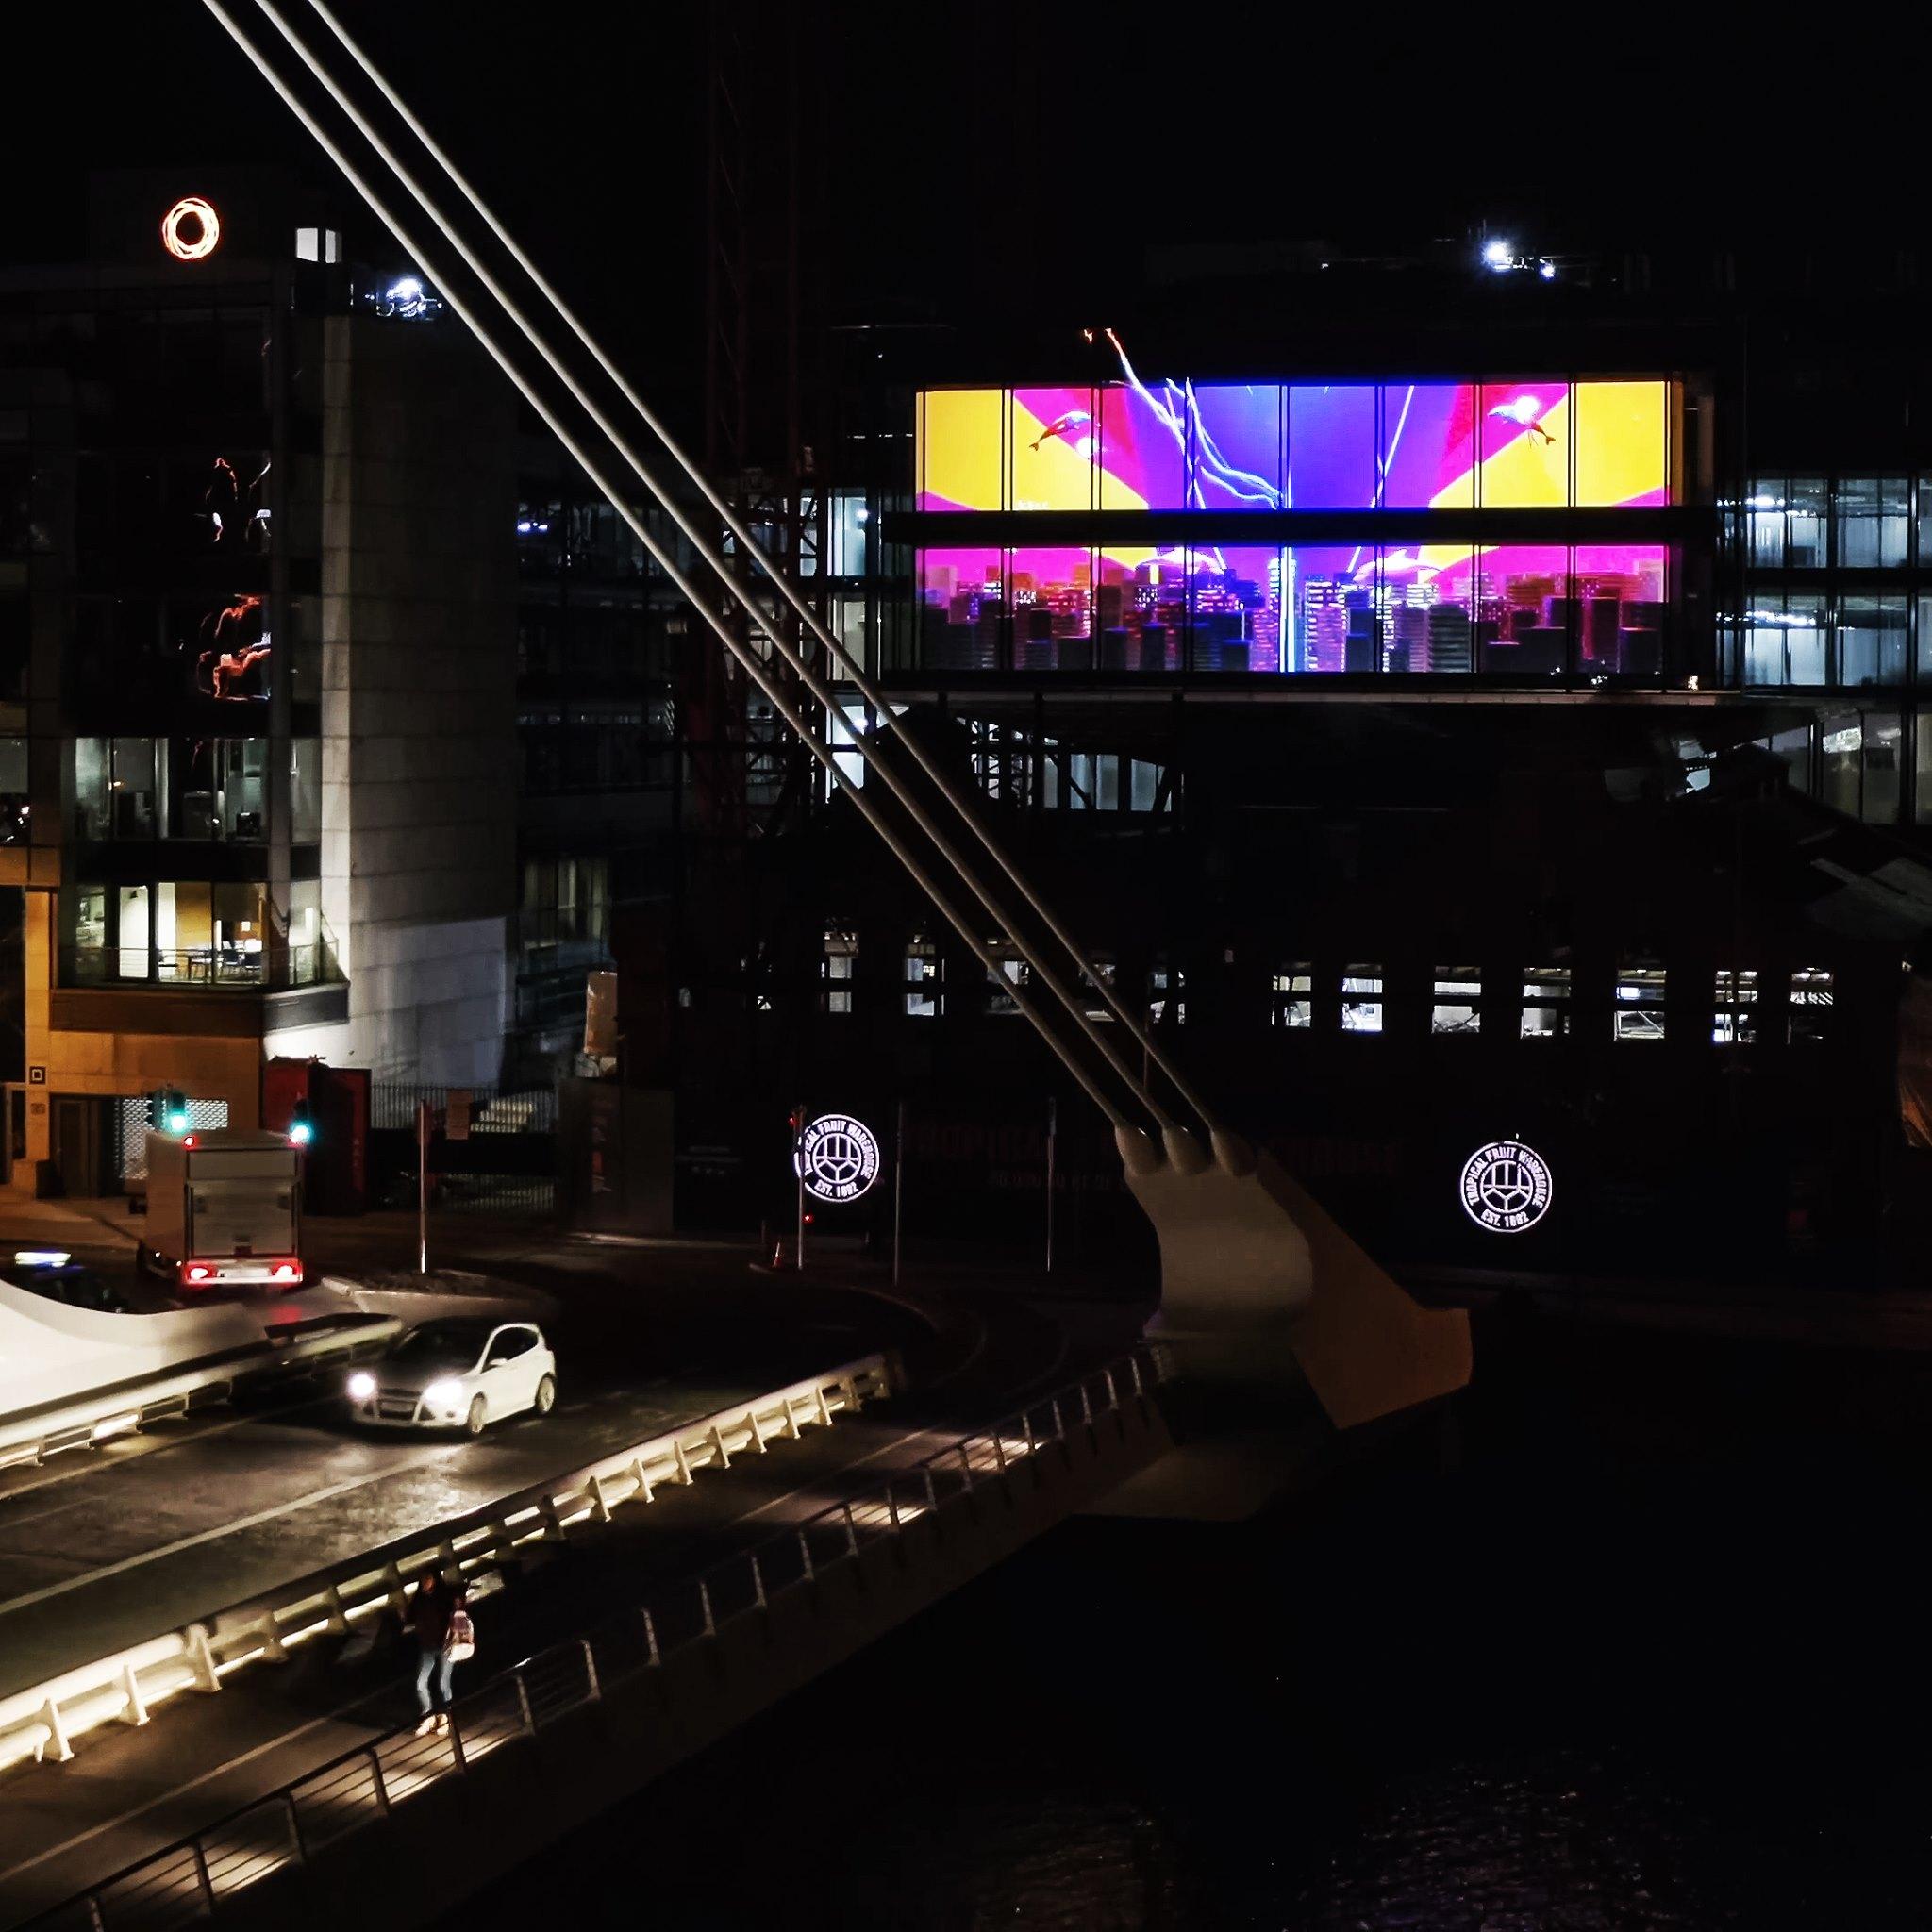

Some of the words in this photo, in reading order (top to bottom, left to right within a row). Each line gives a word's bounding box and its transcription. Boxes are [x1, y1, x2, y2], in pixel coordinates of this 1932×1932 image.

[817, 1120, 847, 1135] FRUIT
[847, 1123, 874, 1179] WAREHOUSE
[1465, 1157, 1489, 1207] TROPICAL
[1485, 1146, 1517, 1162] FRUIT
[1518, 1149, 1547, 1209] WAREHOUSE
